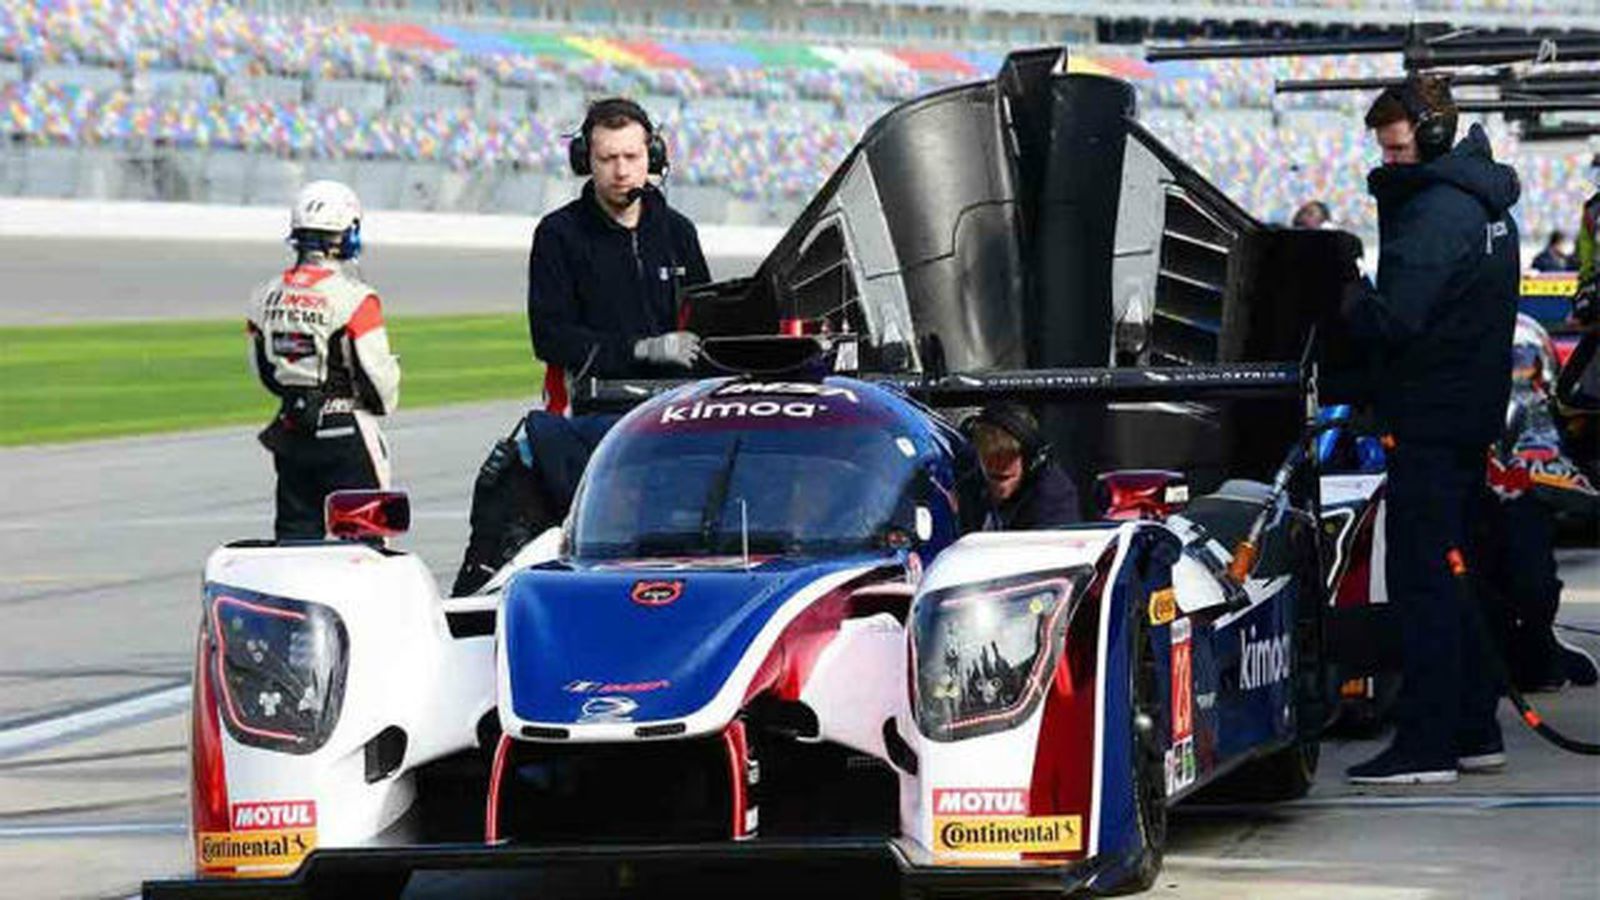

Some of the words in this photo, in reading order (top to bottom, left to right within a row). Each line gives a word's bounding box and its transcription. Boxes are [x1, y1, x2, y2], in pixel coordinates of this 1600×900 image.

[660, 401, 816, 425] kimoa
[936, 792, 1025, 813] MOTUL
[235, 804, 312, 828] MOTUL
[941, 821, 1060, 849] Continental
